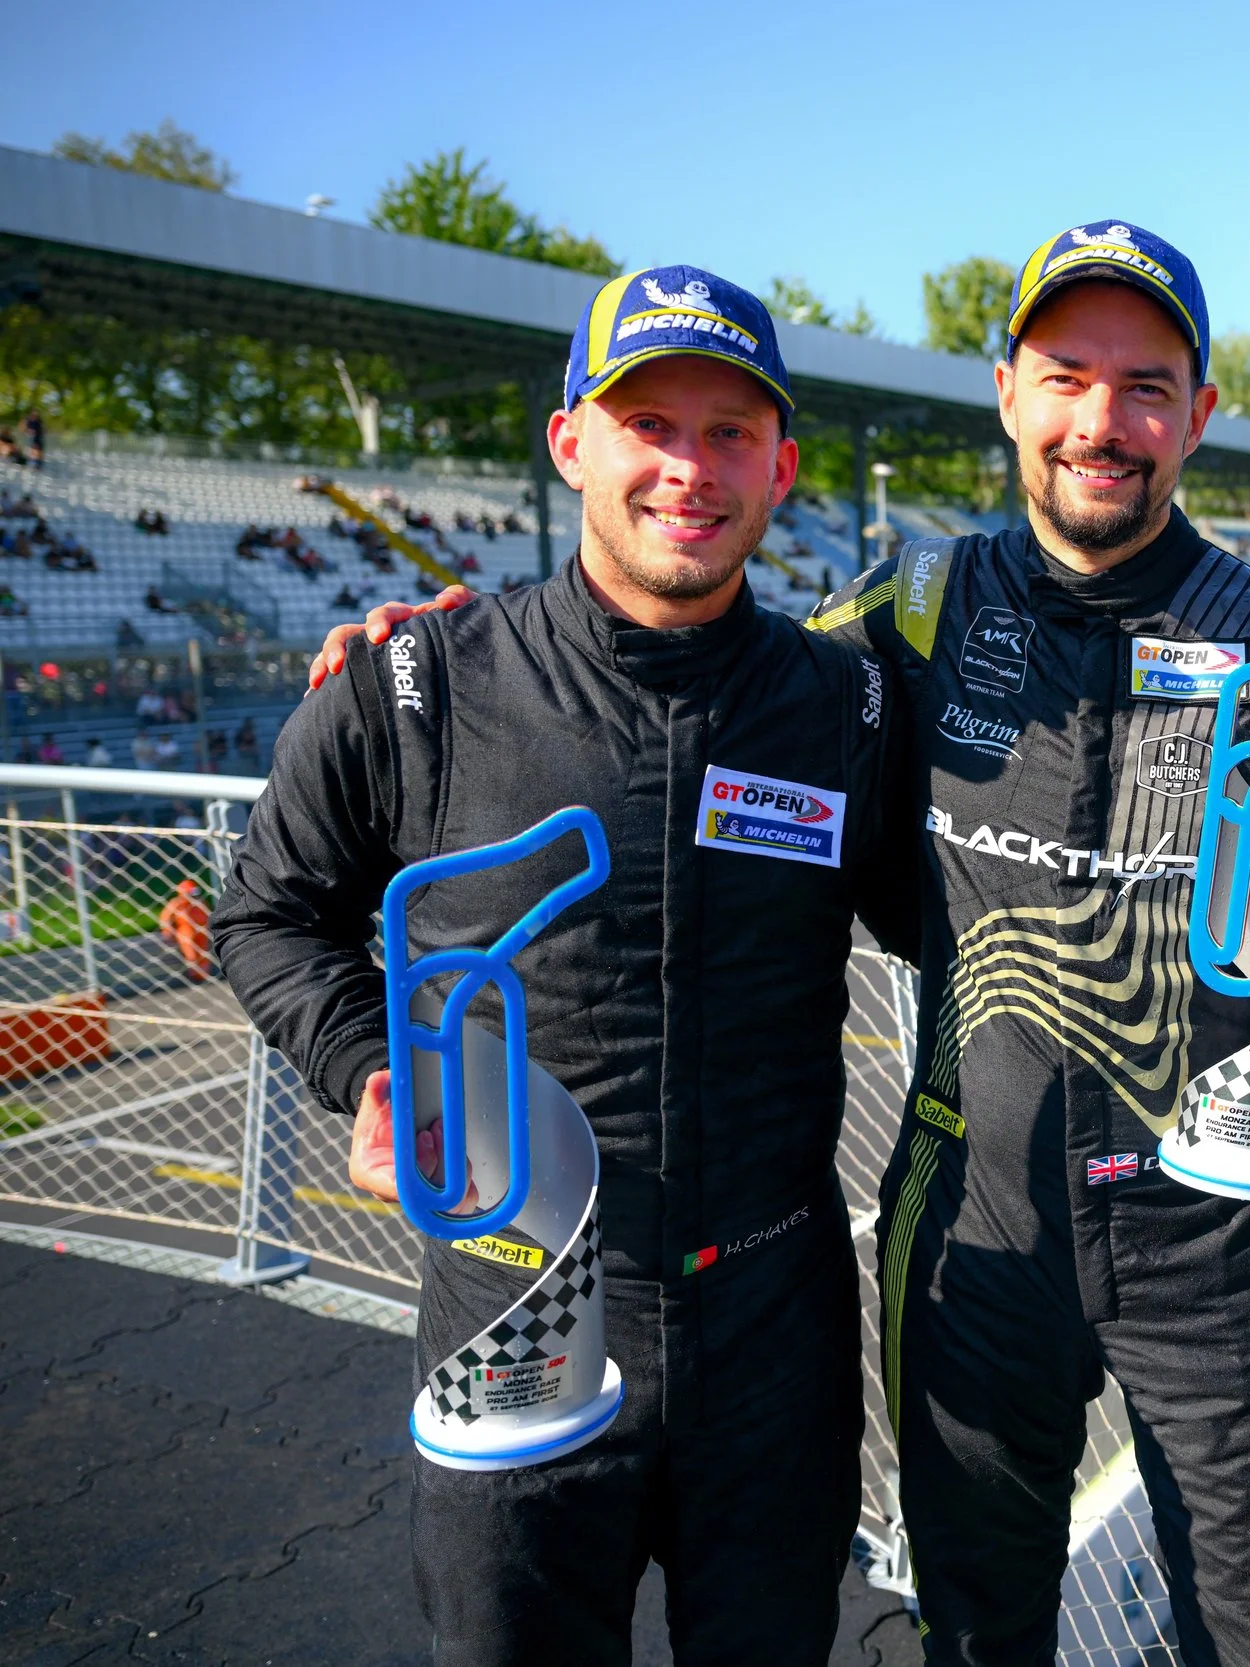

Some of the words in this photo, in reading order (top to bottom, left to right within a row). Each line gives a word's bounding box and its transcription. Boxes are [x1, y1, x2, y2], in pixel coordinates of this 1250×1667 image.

[616, 313, 759, 354] MICHELIN
[908, 551, 939, 616] Sabelt
[389, 634, 424, 711] Sabelt
[964, 654, 1021, 680] BLACKTHORN
[862, 656, 883, 729] Sabelt
[965, 682, 989, 694] PARTNER
[989, 688, 1005, 698] TEAM
[1165, 679, 1223, 690] MICHELI
[940, 702, 1020, 743] Pilgrim
[973, 745, 1014, 761] FOODSERVICE
[1164, 742, 1189, 764] C.J.
[1149, 765, 1201, 781] BUTCHERS
[712, 780, 805, 815] GTOPEN
[746, 781, 805, 798] INTERNATIONAL
[743, 825, 822, 848] MICHELIN
[926, 804, 1199, 895] BLACKTHOR
[918, 1097, 960, 1134] Sabelt
[1205, 1117, 1246, 1132] ENDURANCE
[1205, 1125, 1222, 1134] PRO
[1223, 1129, 1237, 1138] AM
[1214, 1136, 1246, 1146] SEPTEMBER
[462, 1238, 533, 1265] Sabelt
[547, 1355, 566, 1369] 500
[485, 1385, 536, 1396] ENDURANCE
[540, 1377, 561, 1388] RACE
[503, 1375, 543, 1388] MONZA
[486, 1396, 508, 1404] PRO
[512, 1394, 528, 1402] AM
[532, 1385, 559, 1398] FIRST
[501, 1399, 540, 1410] SEPTEMBER
